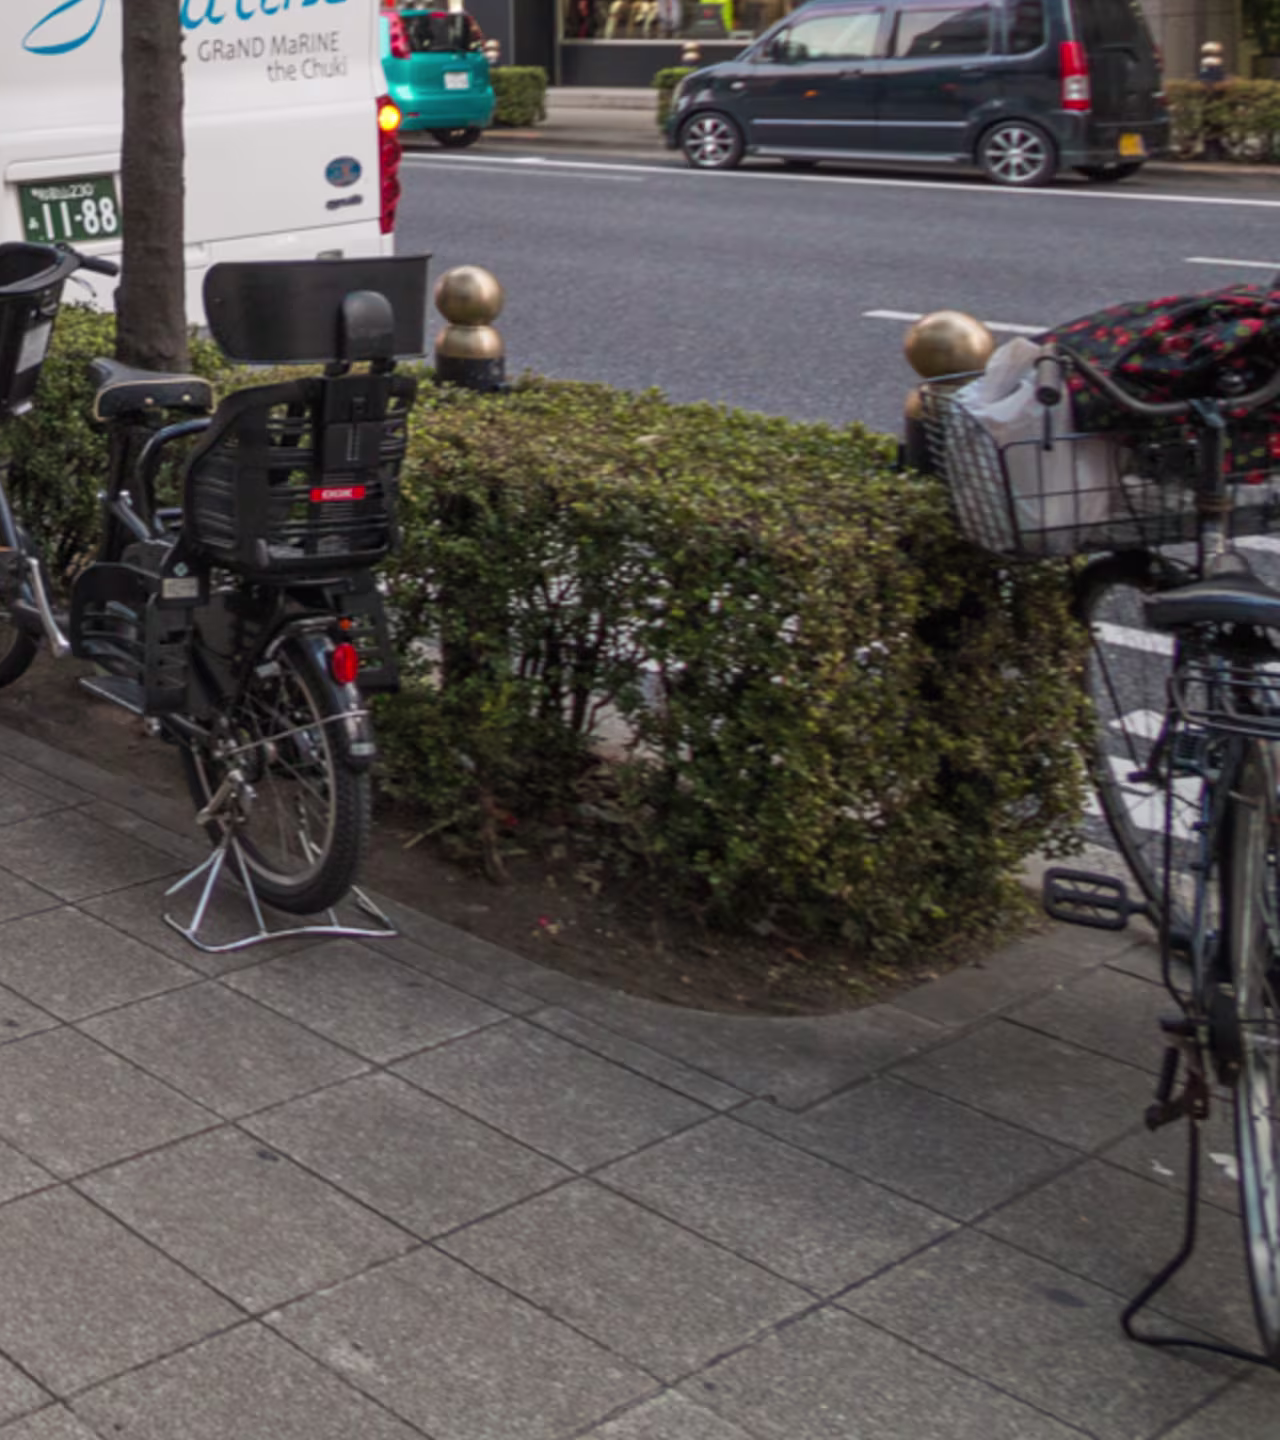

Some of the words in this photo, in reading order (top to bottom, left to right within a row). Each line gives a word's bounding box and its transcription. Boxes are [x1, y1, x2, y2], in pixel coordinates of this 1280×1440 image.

[267, 59, 298, 83] the
[301, 55, 348, 80] Chuki
[41, 196, 118, 240] 11-88
